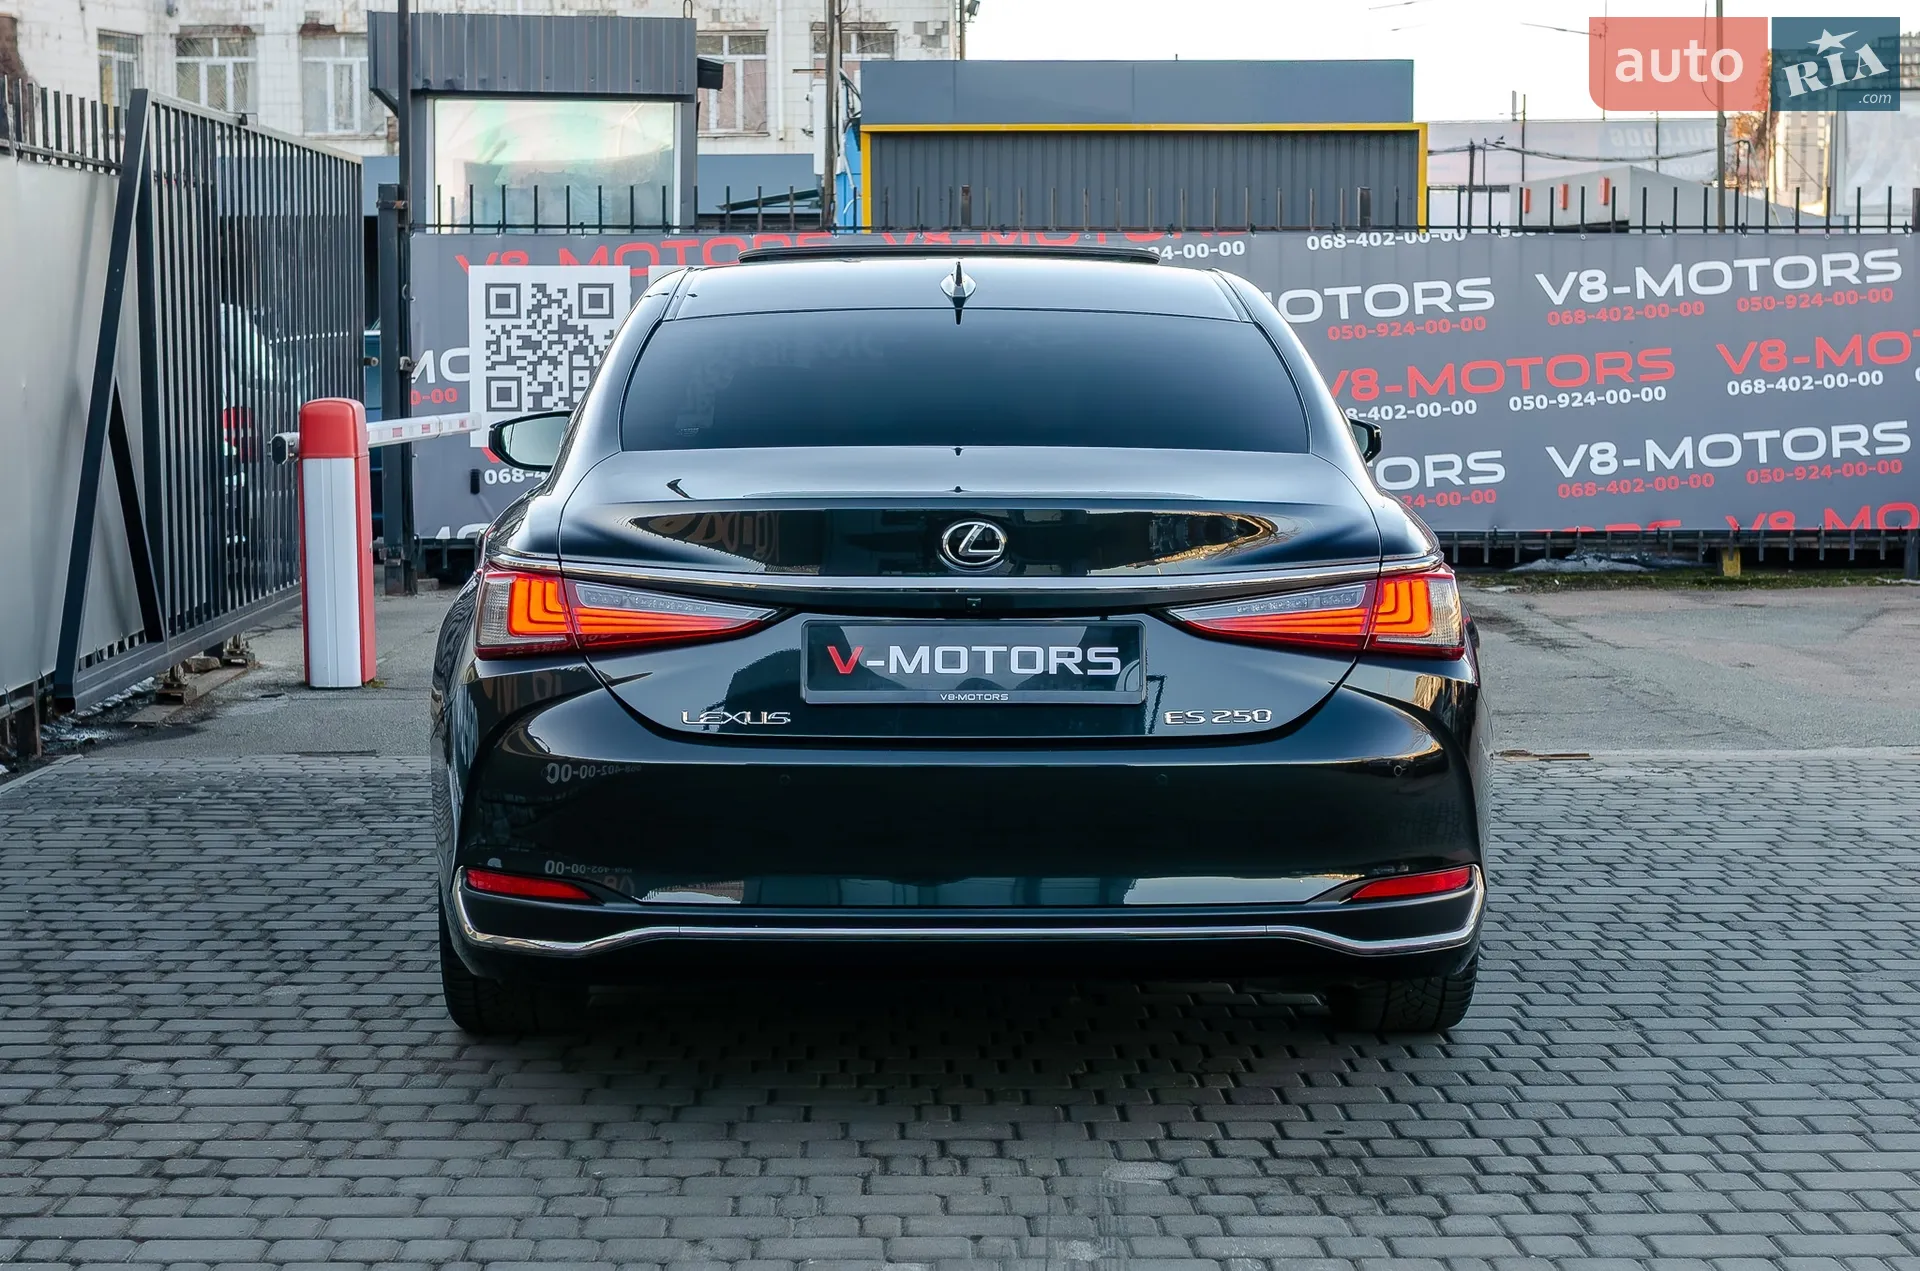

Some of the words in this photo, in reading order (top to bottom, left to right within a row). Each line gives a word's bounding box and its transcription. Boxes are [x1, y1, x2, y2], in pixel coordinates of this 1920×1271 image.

[1535, 248, 1903, 305] V8-MOTORS
[1264, 277, 1496, 324] OTORS
[1547, 302, 1705, 326] 068-402-00-00
[1736, 287, 1894, 313] 050-924-00-00
[1327, 315, 1487, 341] 050-924-00-00
[1716, 329, 1920, 375] V8-MO
[1508, 386, 1667, 413] 050-924-00-00
[1727, 370, 1884, 396] 068-402-00-00
[1545, 420, 1911, 478] V8-MOTORS
[1367, 450, 1507, 490] ORS
[1557, 472, 1716, 499] 068-402-00-00
[1745, 458, 1903, 485] 050-924-00-00
[827, 645, 1121, 676] V-MOTORS
[681, 711, 791, 726] LEXUS
[1163, 709, 1206, 726] ES
[1211, 708, 1272, 725] 250
